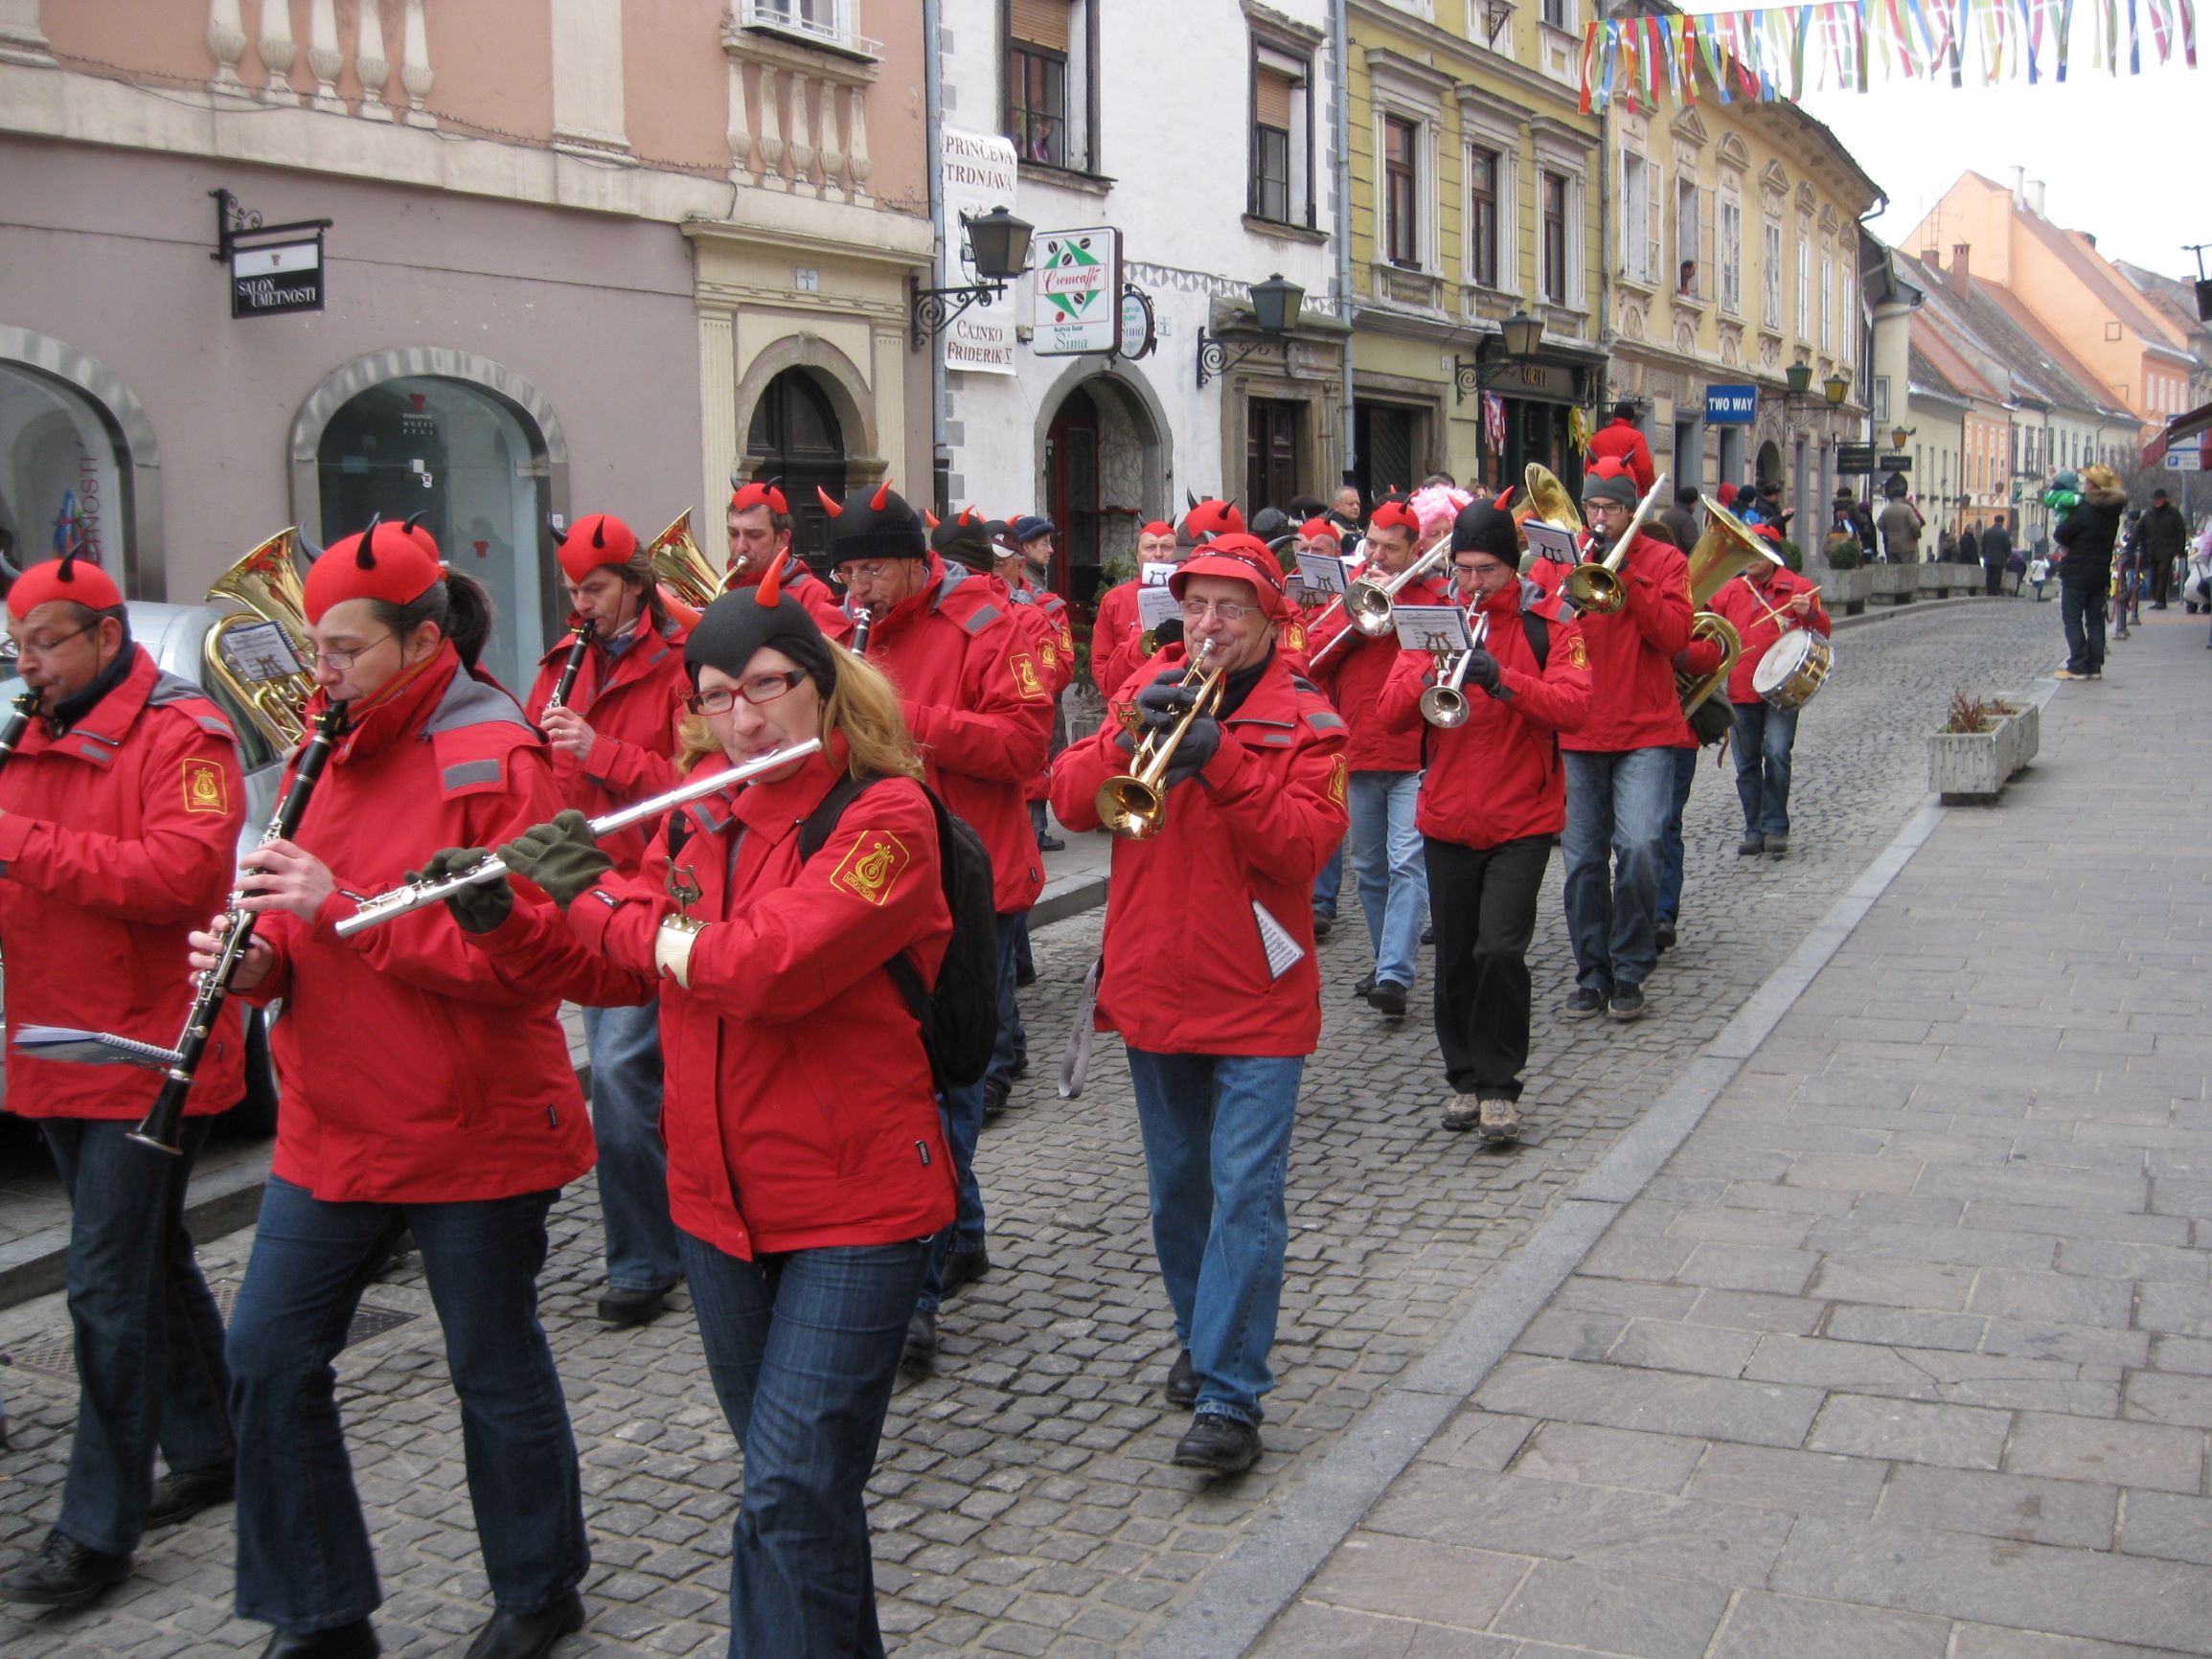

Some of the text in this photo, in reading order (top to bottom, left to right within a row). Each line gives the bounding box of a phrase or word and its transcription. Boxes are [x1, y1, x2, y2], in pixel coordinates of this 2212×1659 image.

[946, 135, 1014, 165] PRINČEVA
[944, 162, 1013, 192] TRDNJAVA
[238, 278, 275, 296] SALON
[250, 286, 316, 307] UMETNOSTI
[956, 319, 1003, 343] CAJNKO
[1054, 332, 1088, 351] Sima
[946, 341, 1002, 364] FRIDERIK
[1708, 397, 1754, 412] TWO WAY
